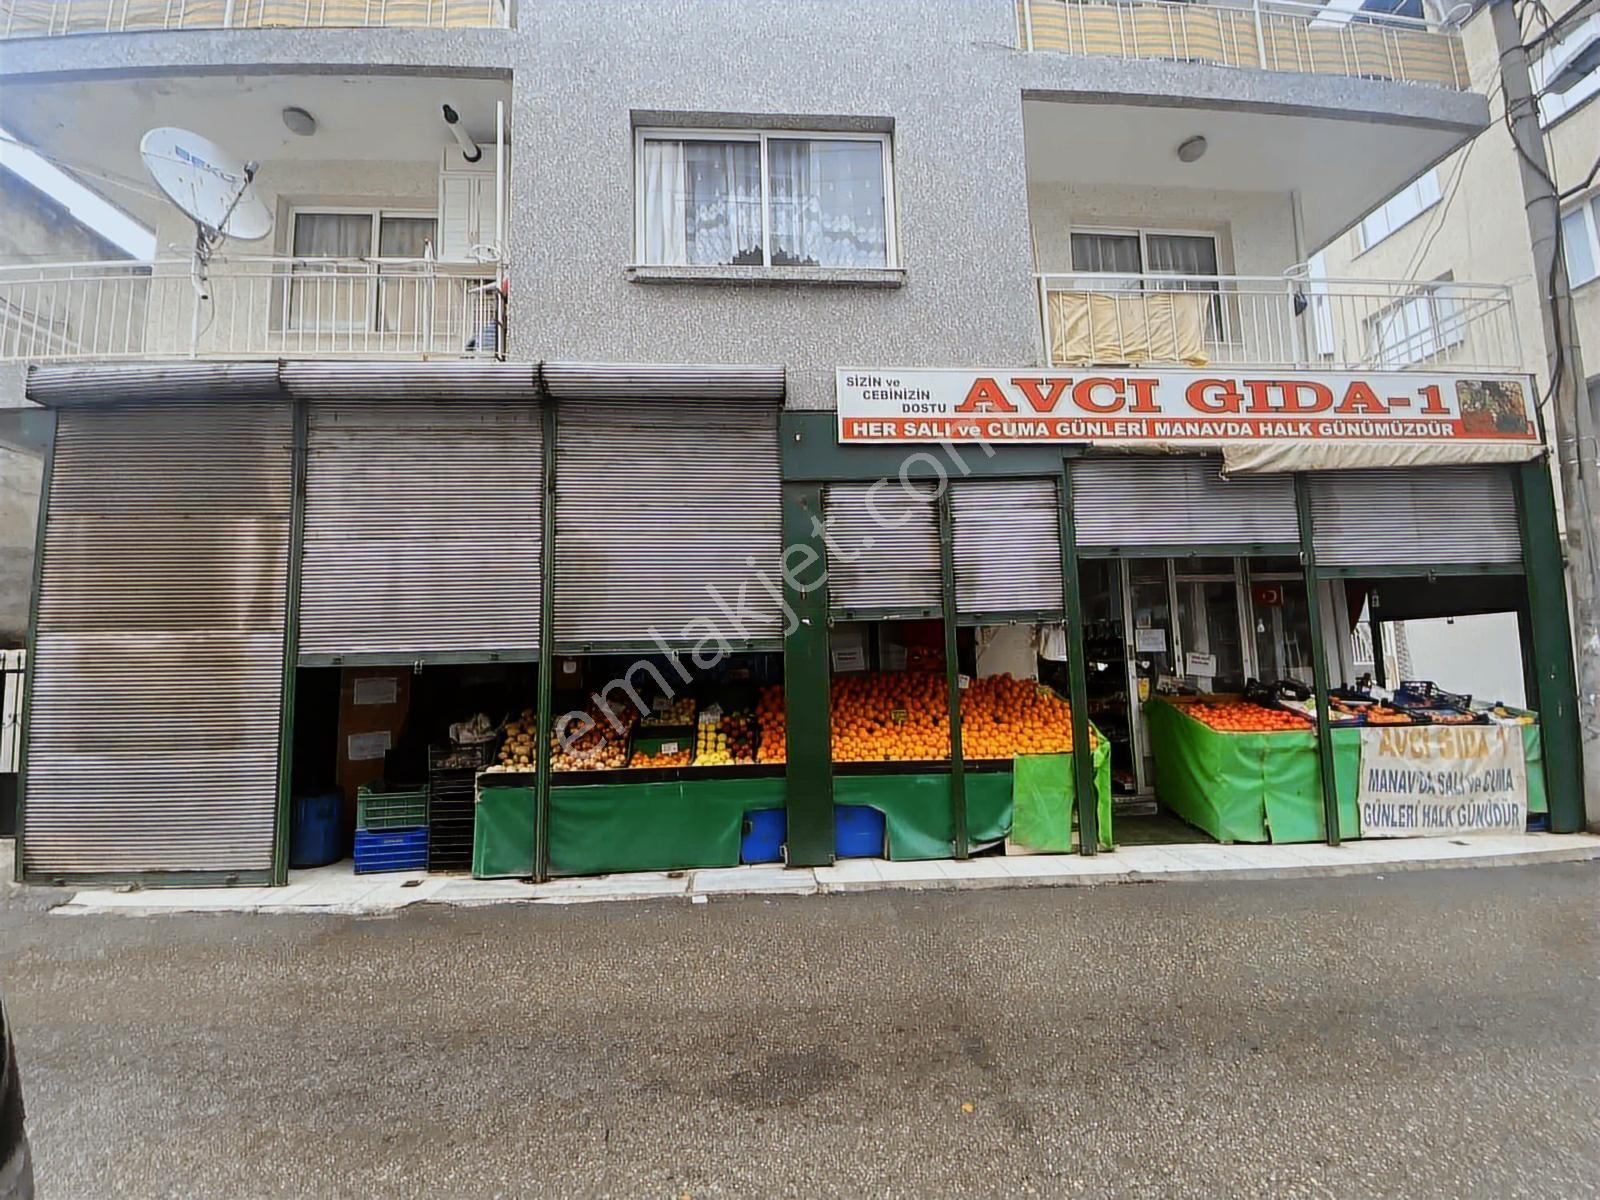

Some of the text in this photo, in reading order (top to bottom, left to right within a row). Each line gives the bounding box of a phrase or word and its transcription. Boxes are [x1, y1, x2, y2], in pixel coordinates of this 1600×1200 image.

[846, 374, 900, 388] SİZİN ve
[862, 387, 931, 401] CEBİNİZİN
[954, 377, 1451, 415] AVCI GIDA-1
[902, 403, 947, 413] DOSTU
[853, 418, 1454, 438] HER SALI ve CUMA GÜNLERİ MANAVDA HALK GÜNÜMÜZDÜR
[1363, 799, 1420, 828] GÜNLERİ
[1422, 803, 1454, 828] HALK
